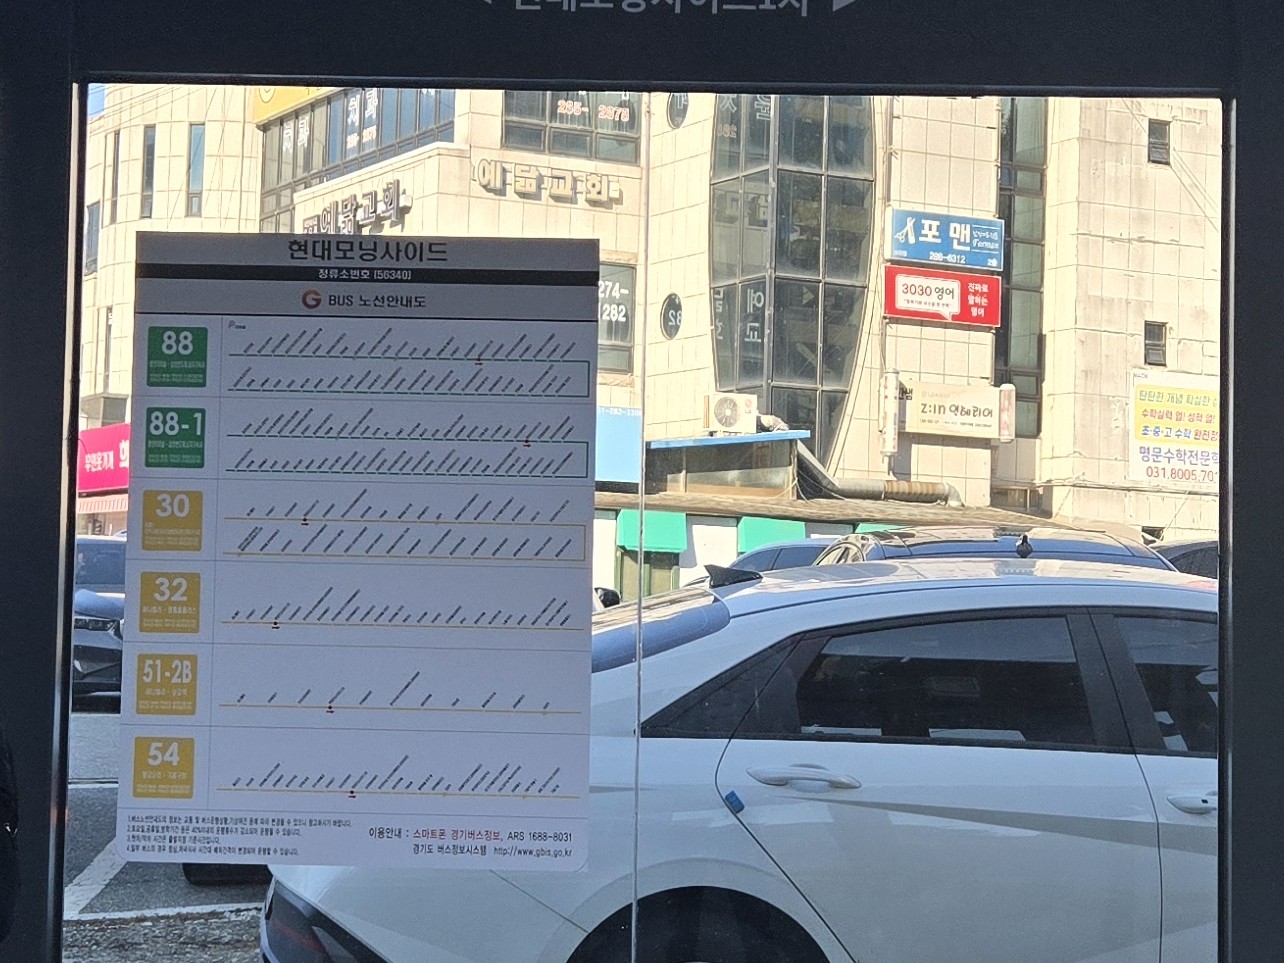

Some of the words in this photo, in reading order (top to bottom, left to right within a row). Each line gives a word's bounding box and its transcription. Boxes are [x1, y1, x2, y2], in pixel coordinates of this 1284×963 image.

[478, 159, 609, 202] 예닮교회
[287, 239, 448, 262] 현대모닝사이드
[318, 269, 371, 280] 정류소번호
[328, 294, 354, 307] BUS
[359, 295, 427, 309] 노선안내도
[161, 331, 194, 355] 88
[149, 411, 203, 436] 88-1
[155, 493, 191, 518] 30
[153, 577, 188, 601] 32
[142, 659, 193, 684] 51-2B
[147, 742, 180, 766] 54
[507, 831, 525, 841] ARS
[529, 832, 573, 843] 1688-8031
